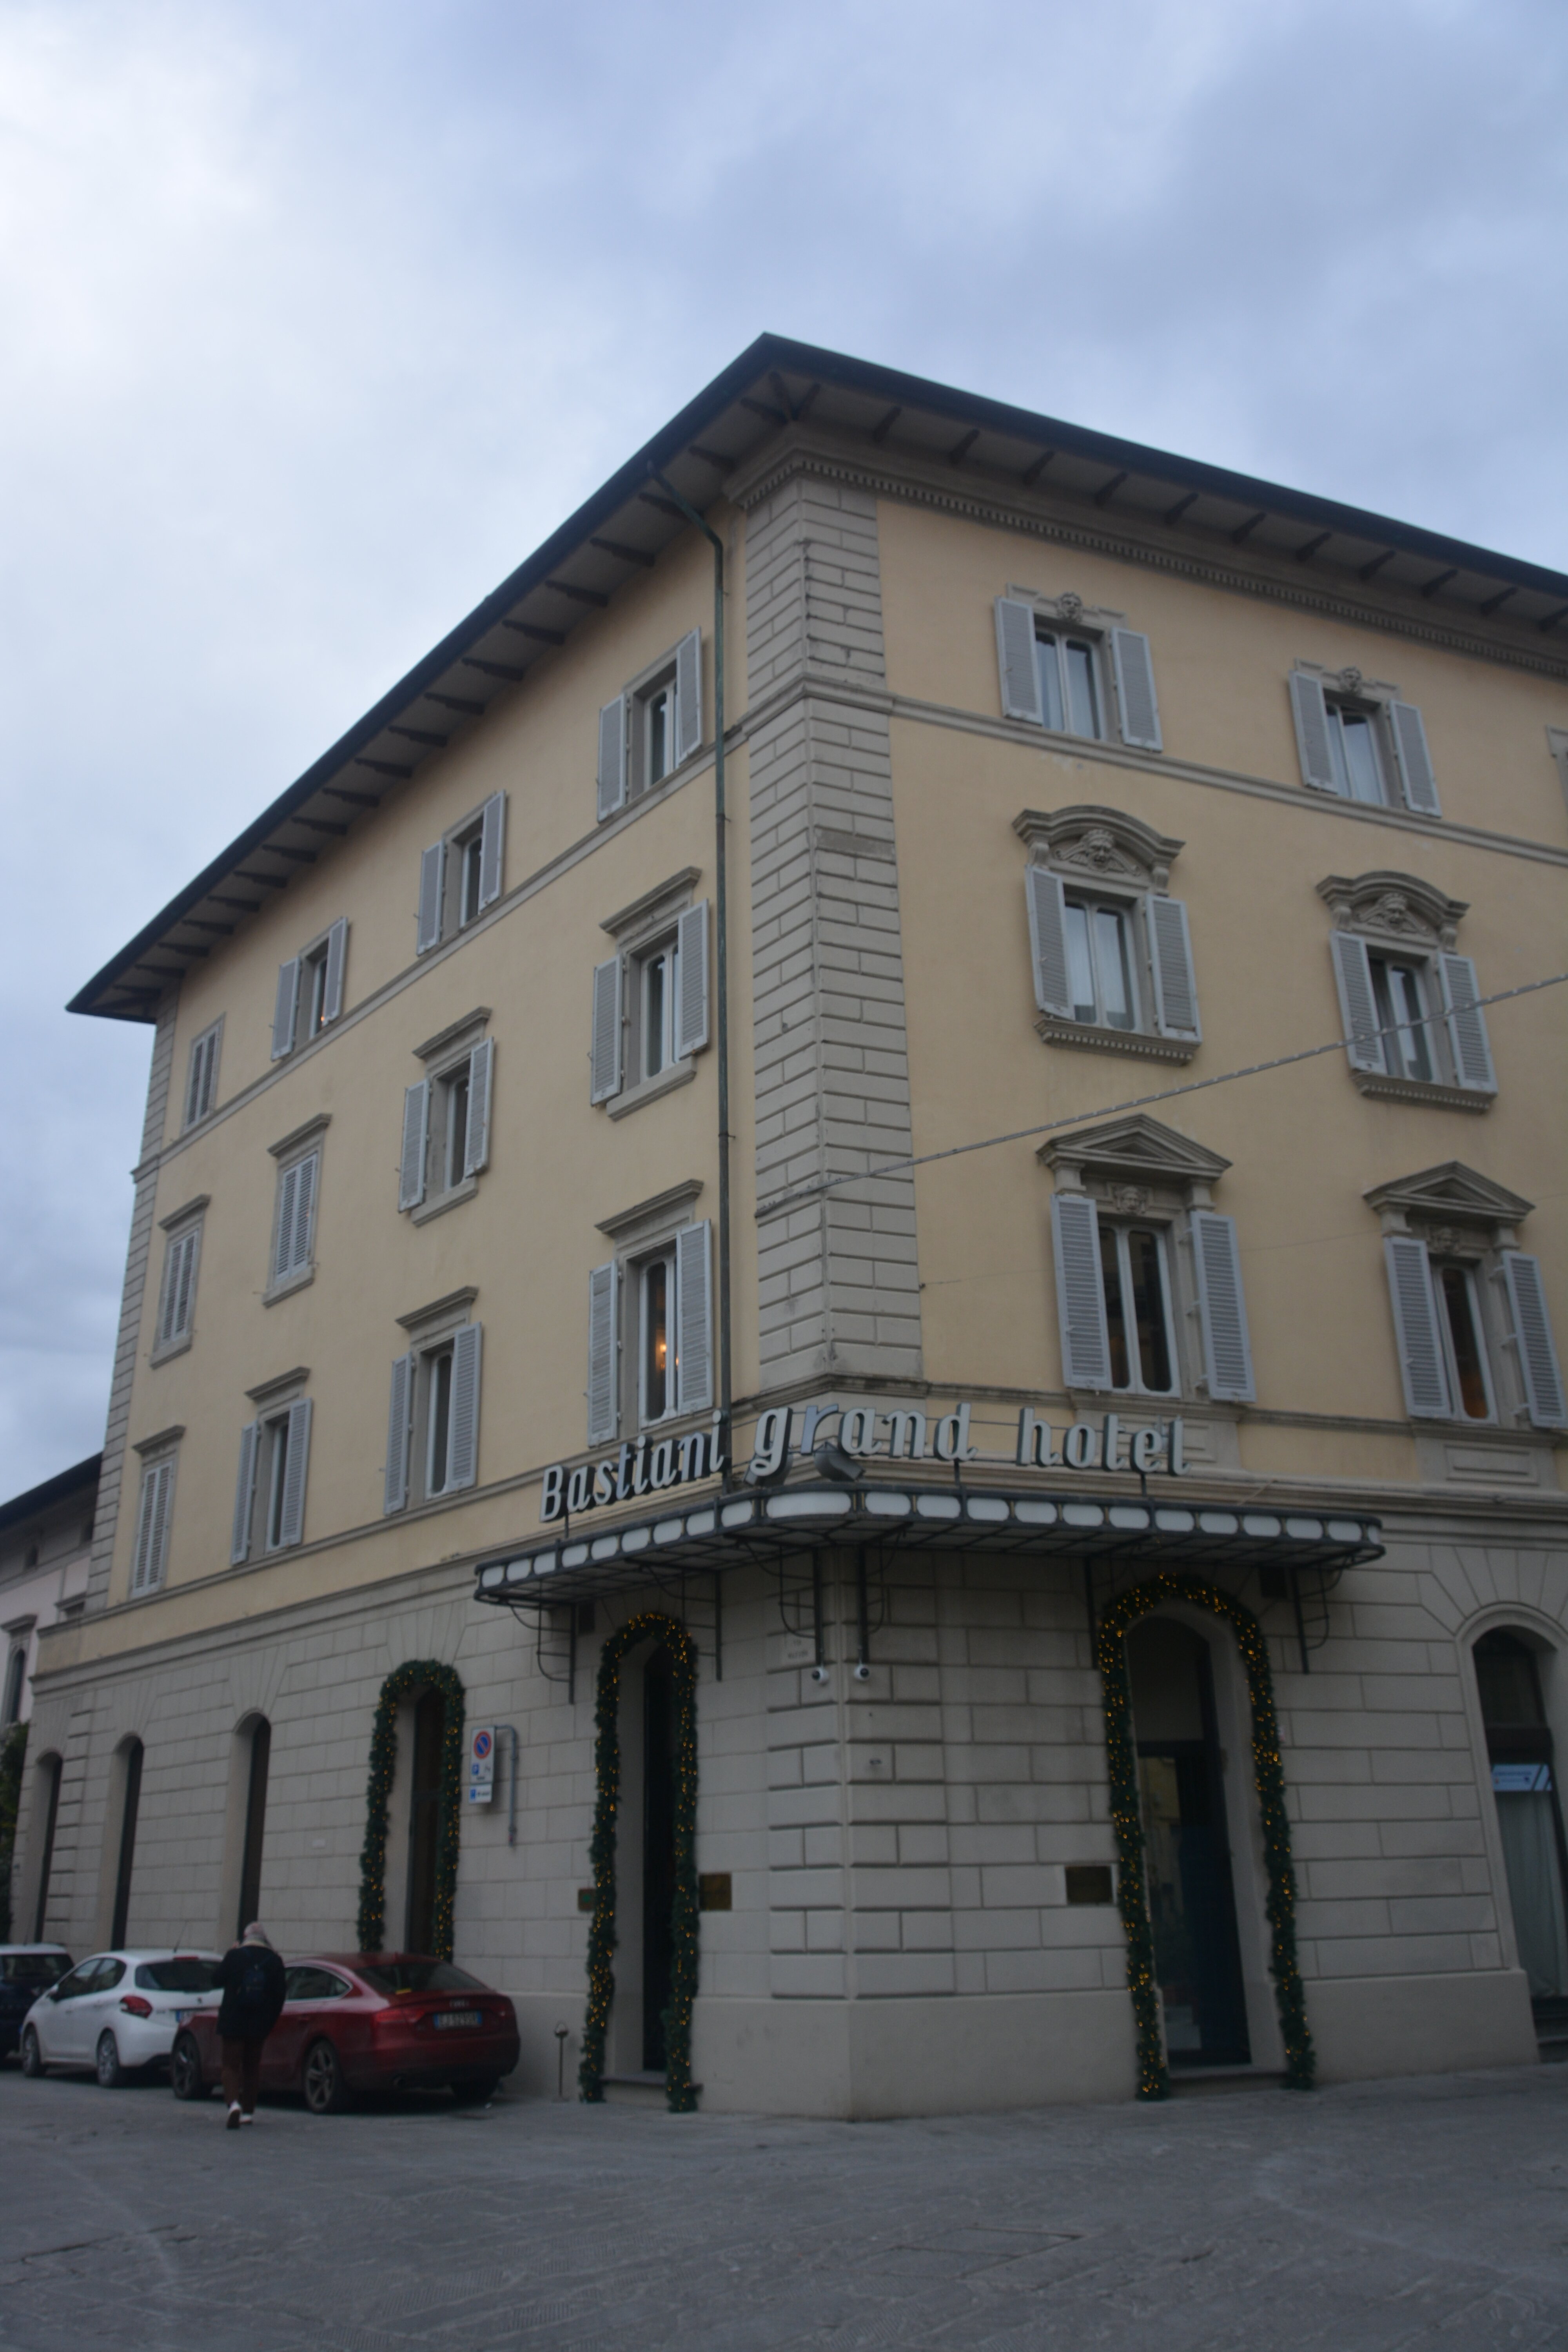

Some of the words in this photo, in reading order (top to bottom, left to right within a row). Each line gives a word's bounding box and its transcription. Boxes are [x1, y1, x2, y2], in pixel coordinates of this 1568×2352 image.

[540, 1410, 727, 1523] Bastiani
[749, 1402, 979, 1477] grand
[1017, 1406, 1192, 1476] hotel
